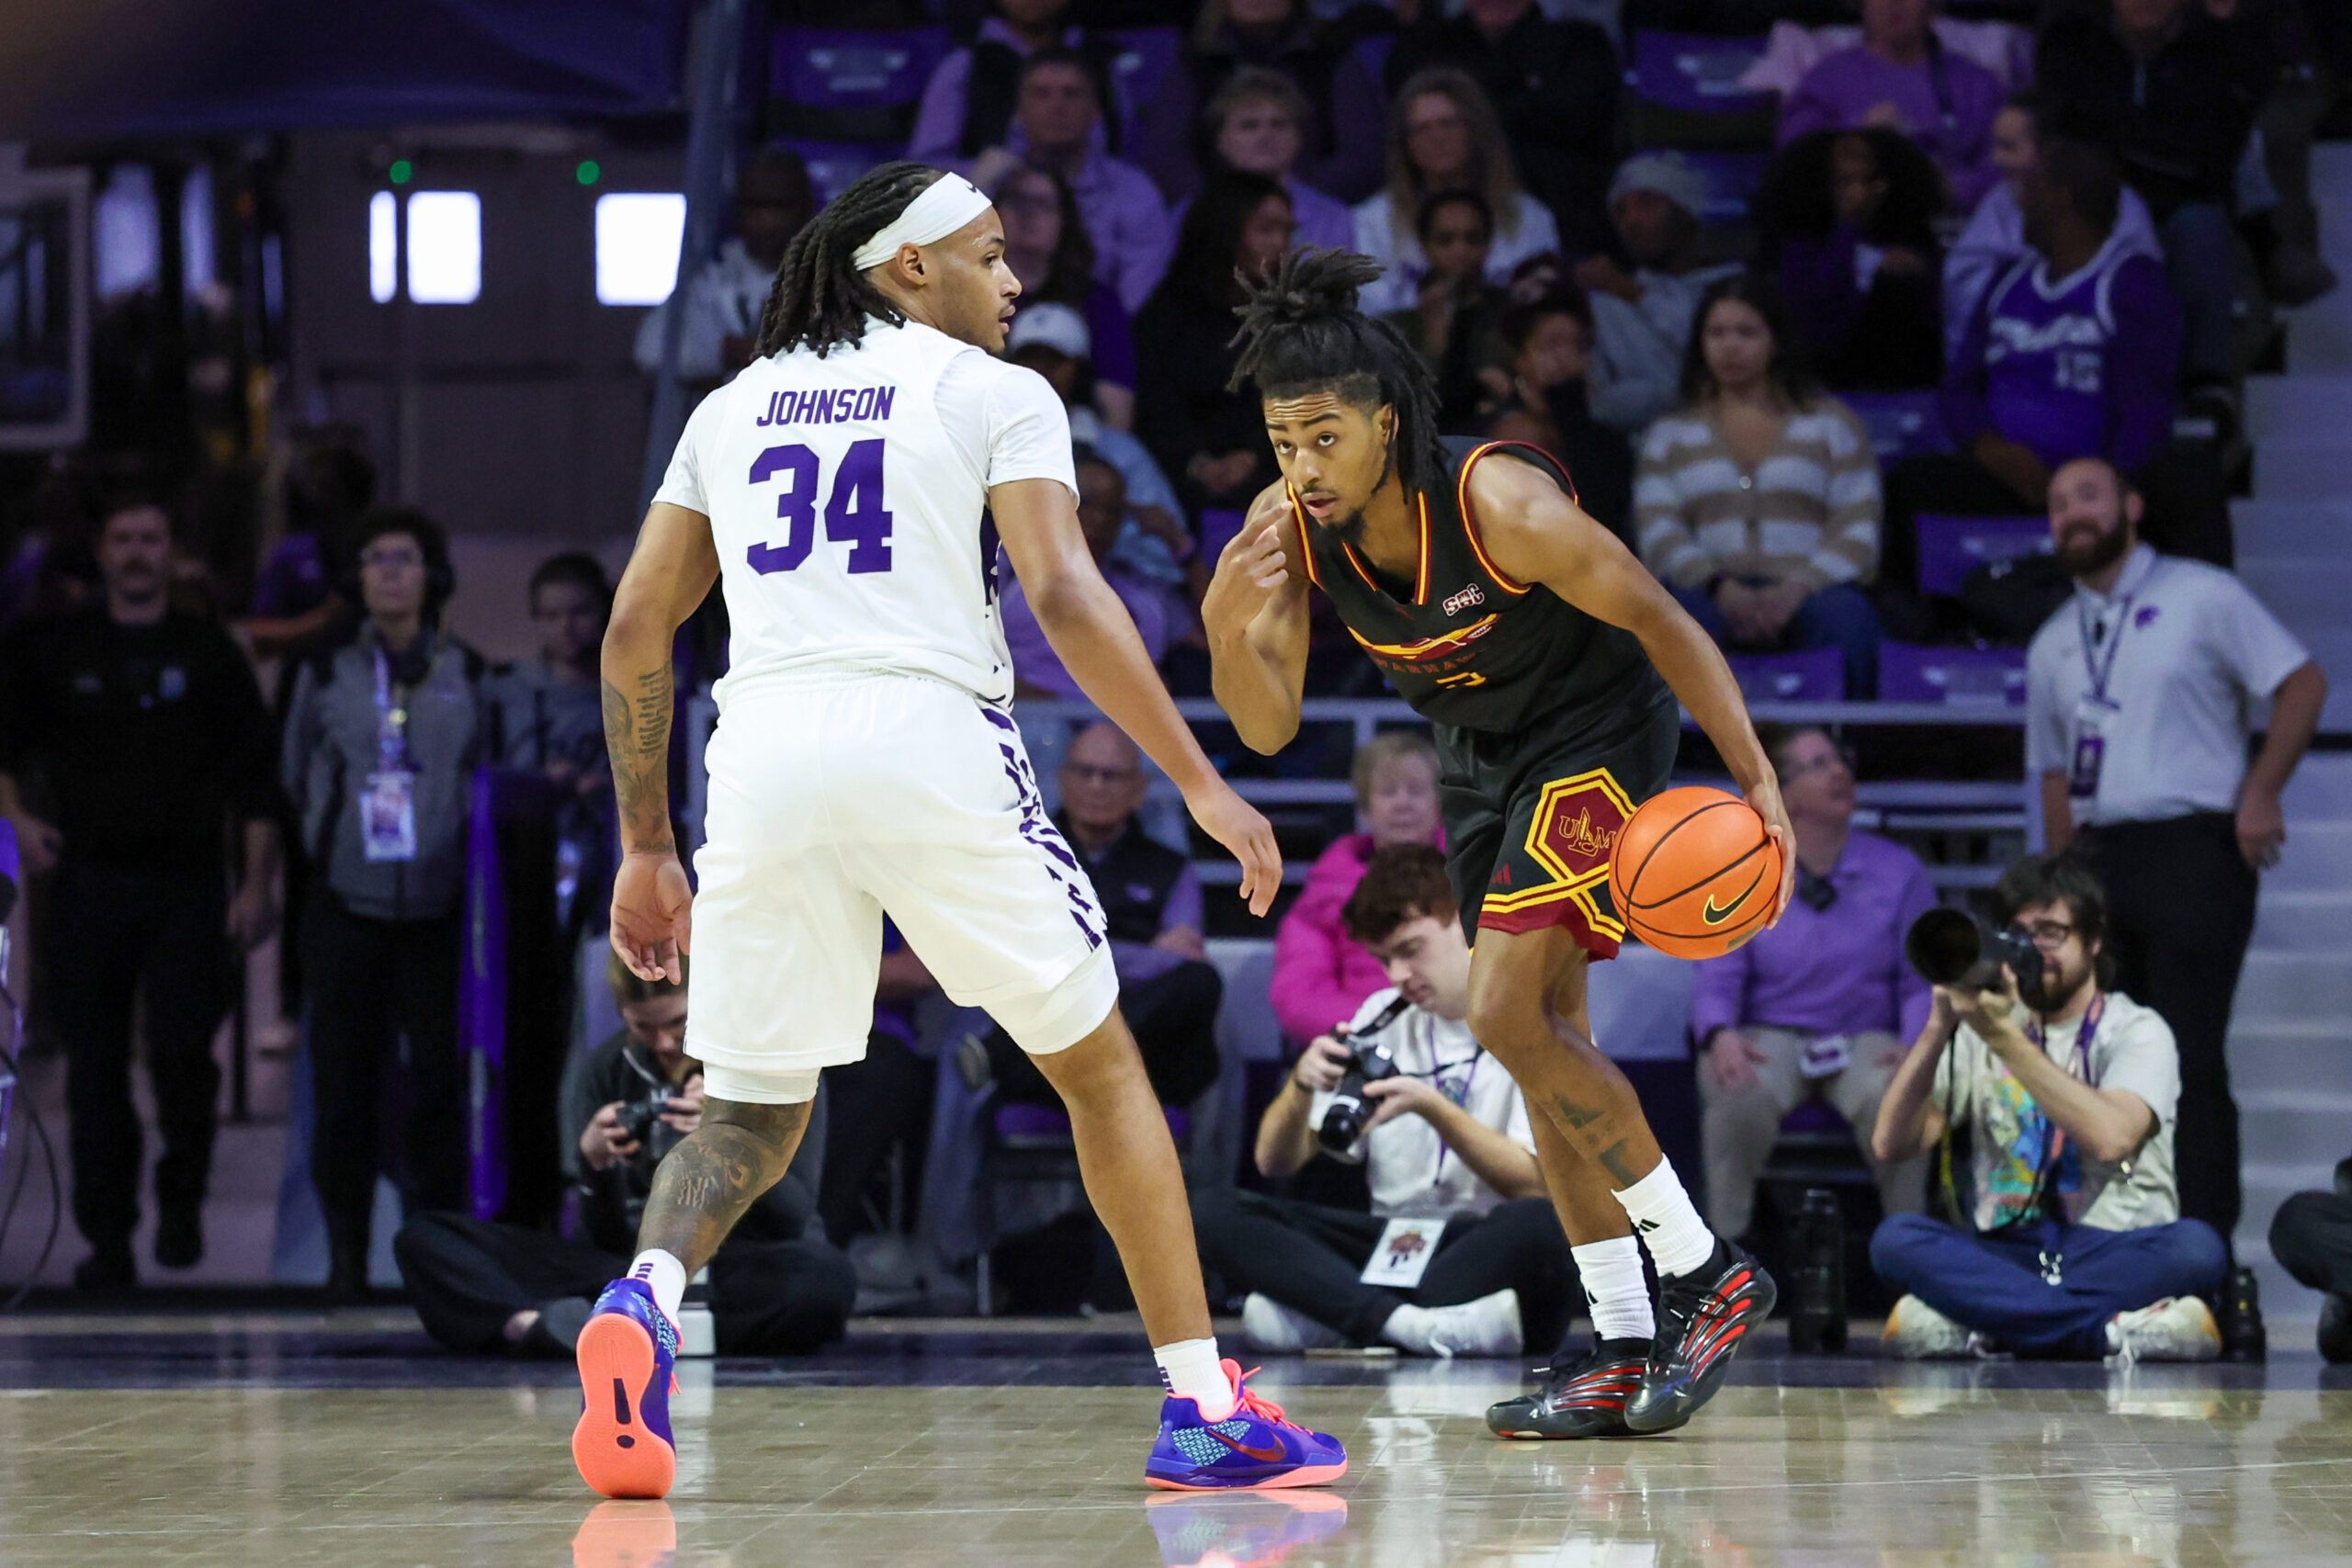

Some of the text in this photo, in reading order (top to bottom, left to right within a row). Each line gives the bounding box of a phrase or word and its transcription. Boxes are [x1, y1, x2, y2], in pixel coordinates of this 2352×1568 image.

[757, 386, 896, 426] JOHNSON
[747, 438, 893, 576] 34
[1559, 807, 1616, 857] ULM
